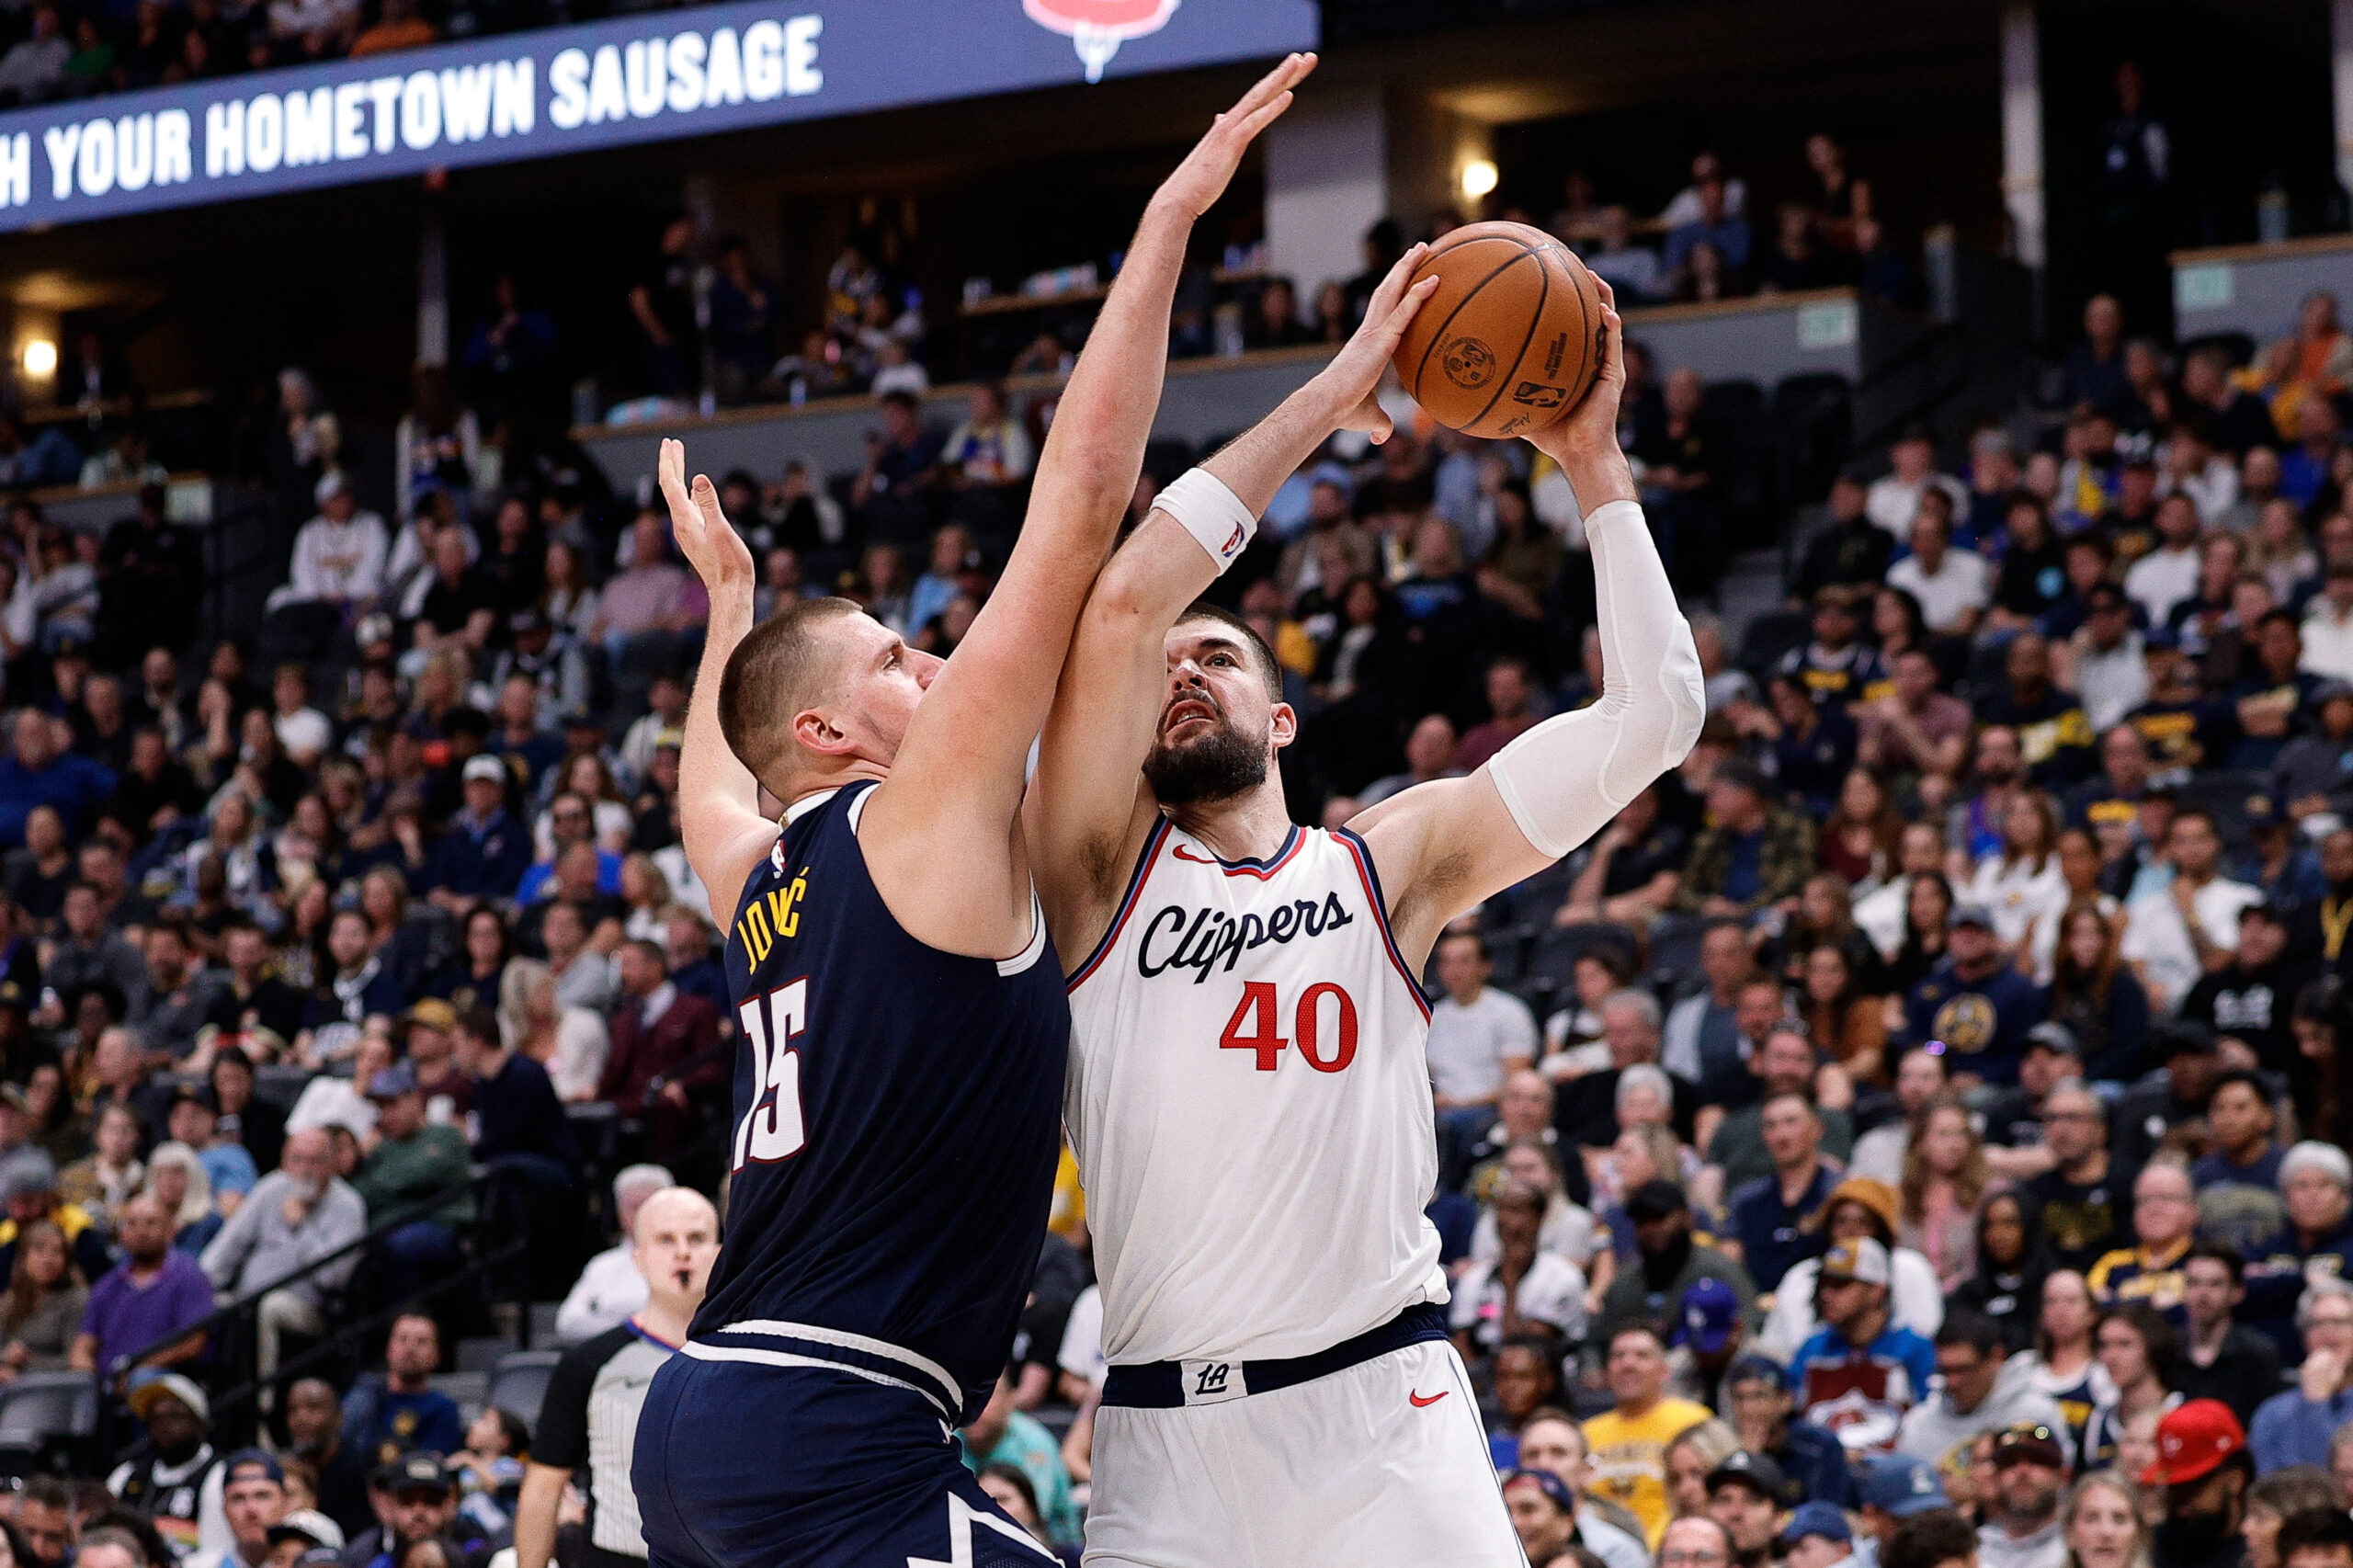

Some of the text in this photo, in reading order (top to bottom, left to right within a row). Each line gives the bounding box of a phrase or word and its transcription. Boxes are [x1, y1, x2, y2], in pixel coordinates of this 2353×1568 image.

[44, 108, 191, 200] YOUR
[205, 57, 535, 178] HOMETOWN
[549, 13, 824, 130] SAUSAGE
[1138, 891, 1353, 984] Clippers
[1219, 981, 1358, 1073] 40
[731, 974, 809, 1175] 15
[1195, 1363, 1229, 1395] LA
